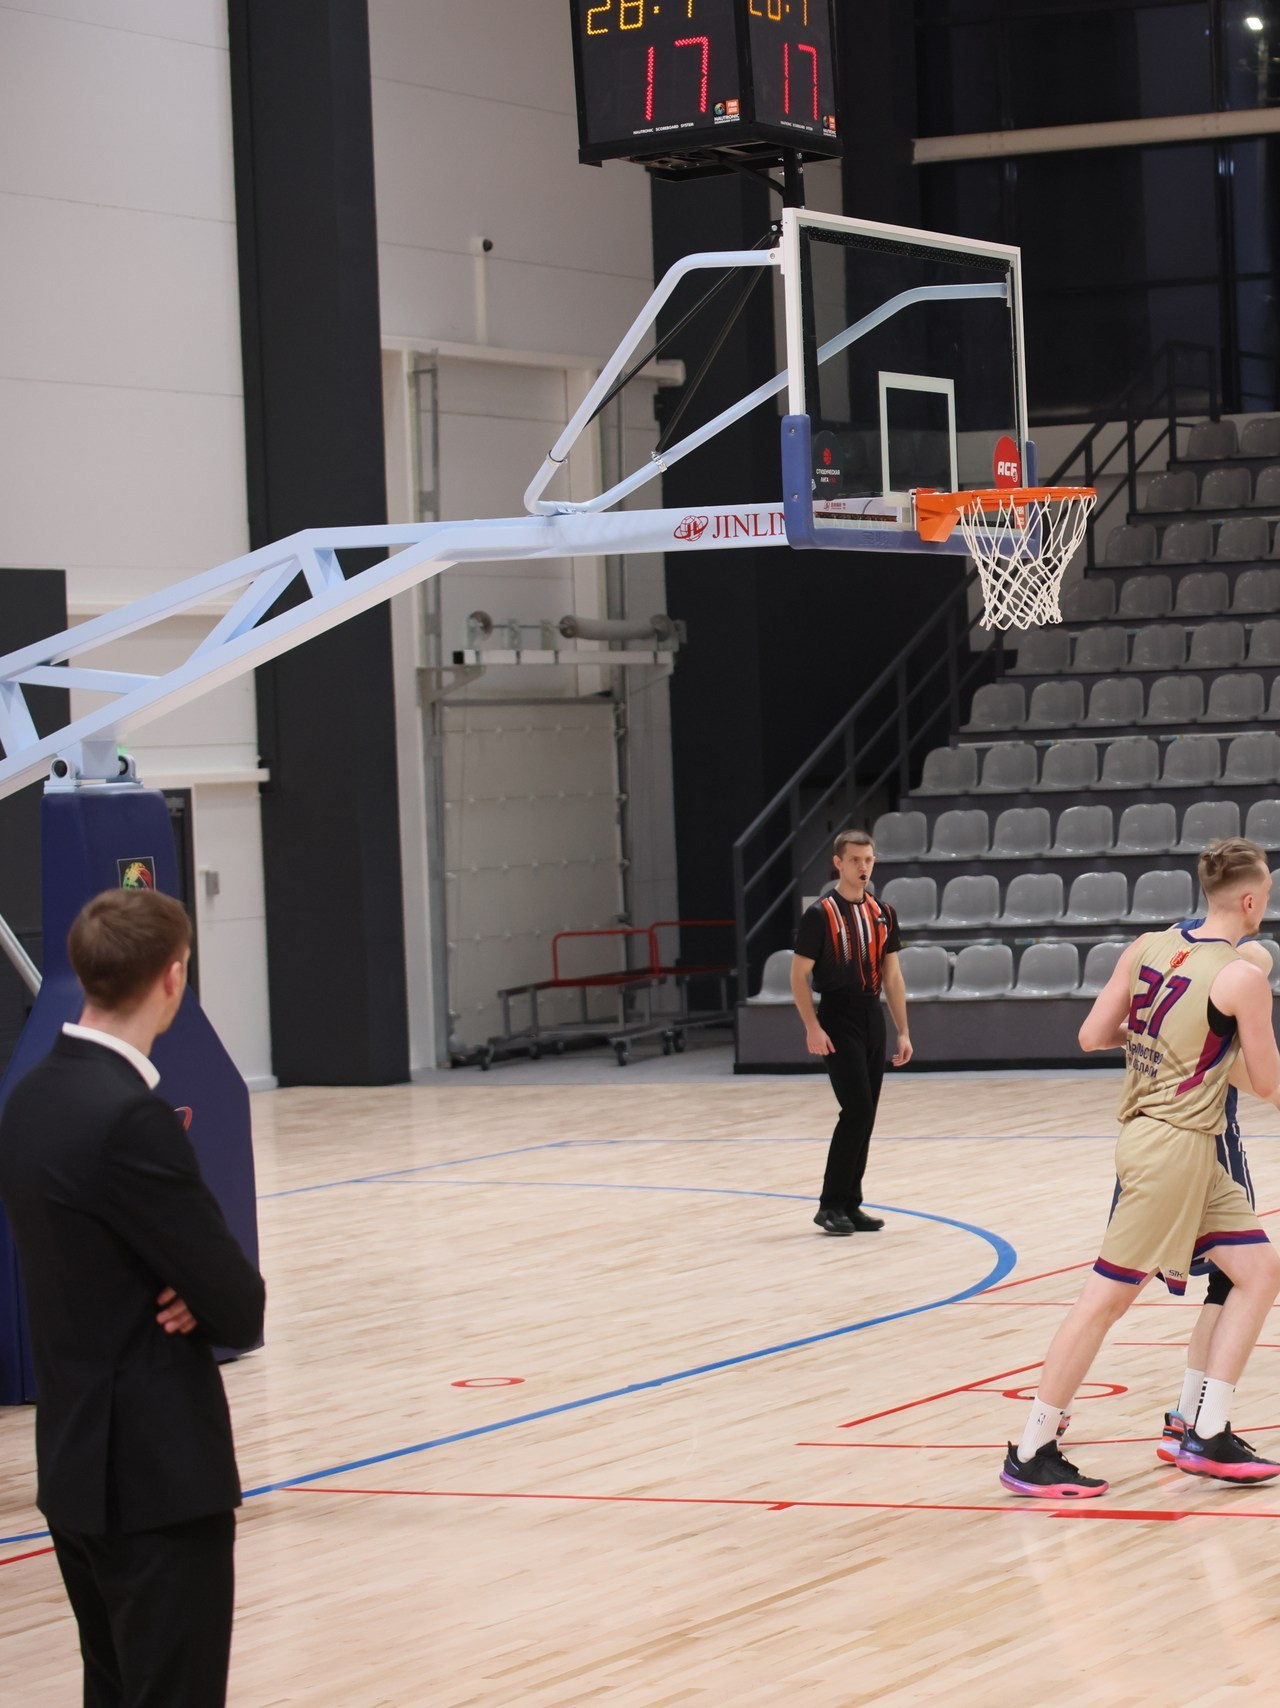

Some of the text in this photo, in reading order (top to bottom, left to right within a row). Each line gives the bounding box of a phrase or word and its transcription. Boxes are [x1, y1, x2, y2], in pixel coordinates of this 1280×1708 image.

[645, 36, 709, 120] 17
[783, 42, 818, 120] 17
[1128, 964, 1192, 1039] 27
[1168, 1269, 1184, 1278] STK
